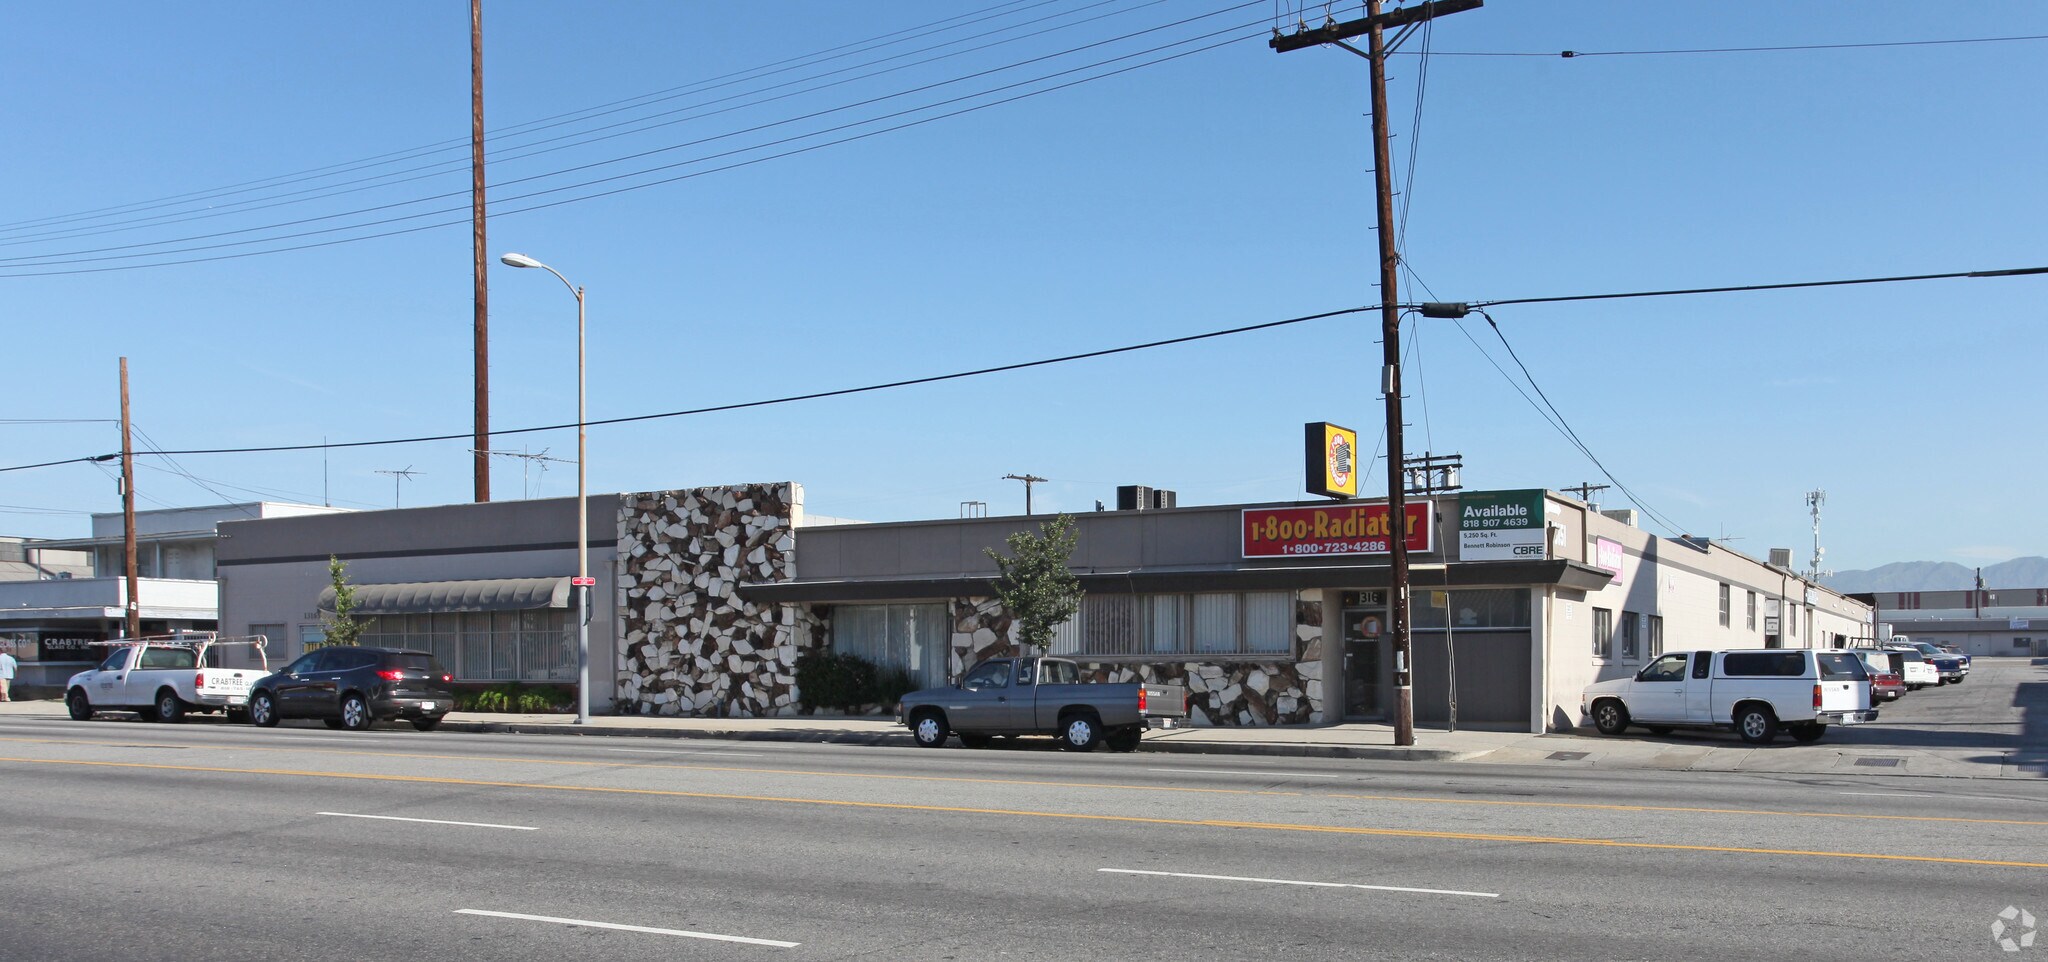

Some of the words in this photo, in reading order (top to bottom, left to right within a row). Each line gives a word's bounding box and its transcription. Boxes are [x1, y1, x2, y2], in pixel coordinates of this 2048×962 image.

[1463, 504, 1528, 517] Available
[1463, 519, 1480, 528] 818
[1482, 518, 1500, 527] 907
[1503, 518, 1528, 526] 4639
[1513, 546, 1543, 555] CBRE
[211, 677, 243, 687] CRABTREE
